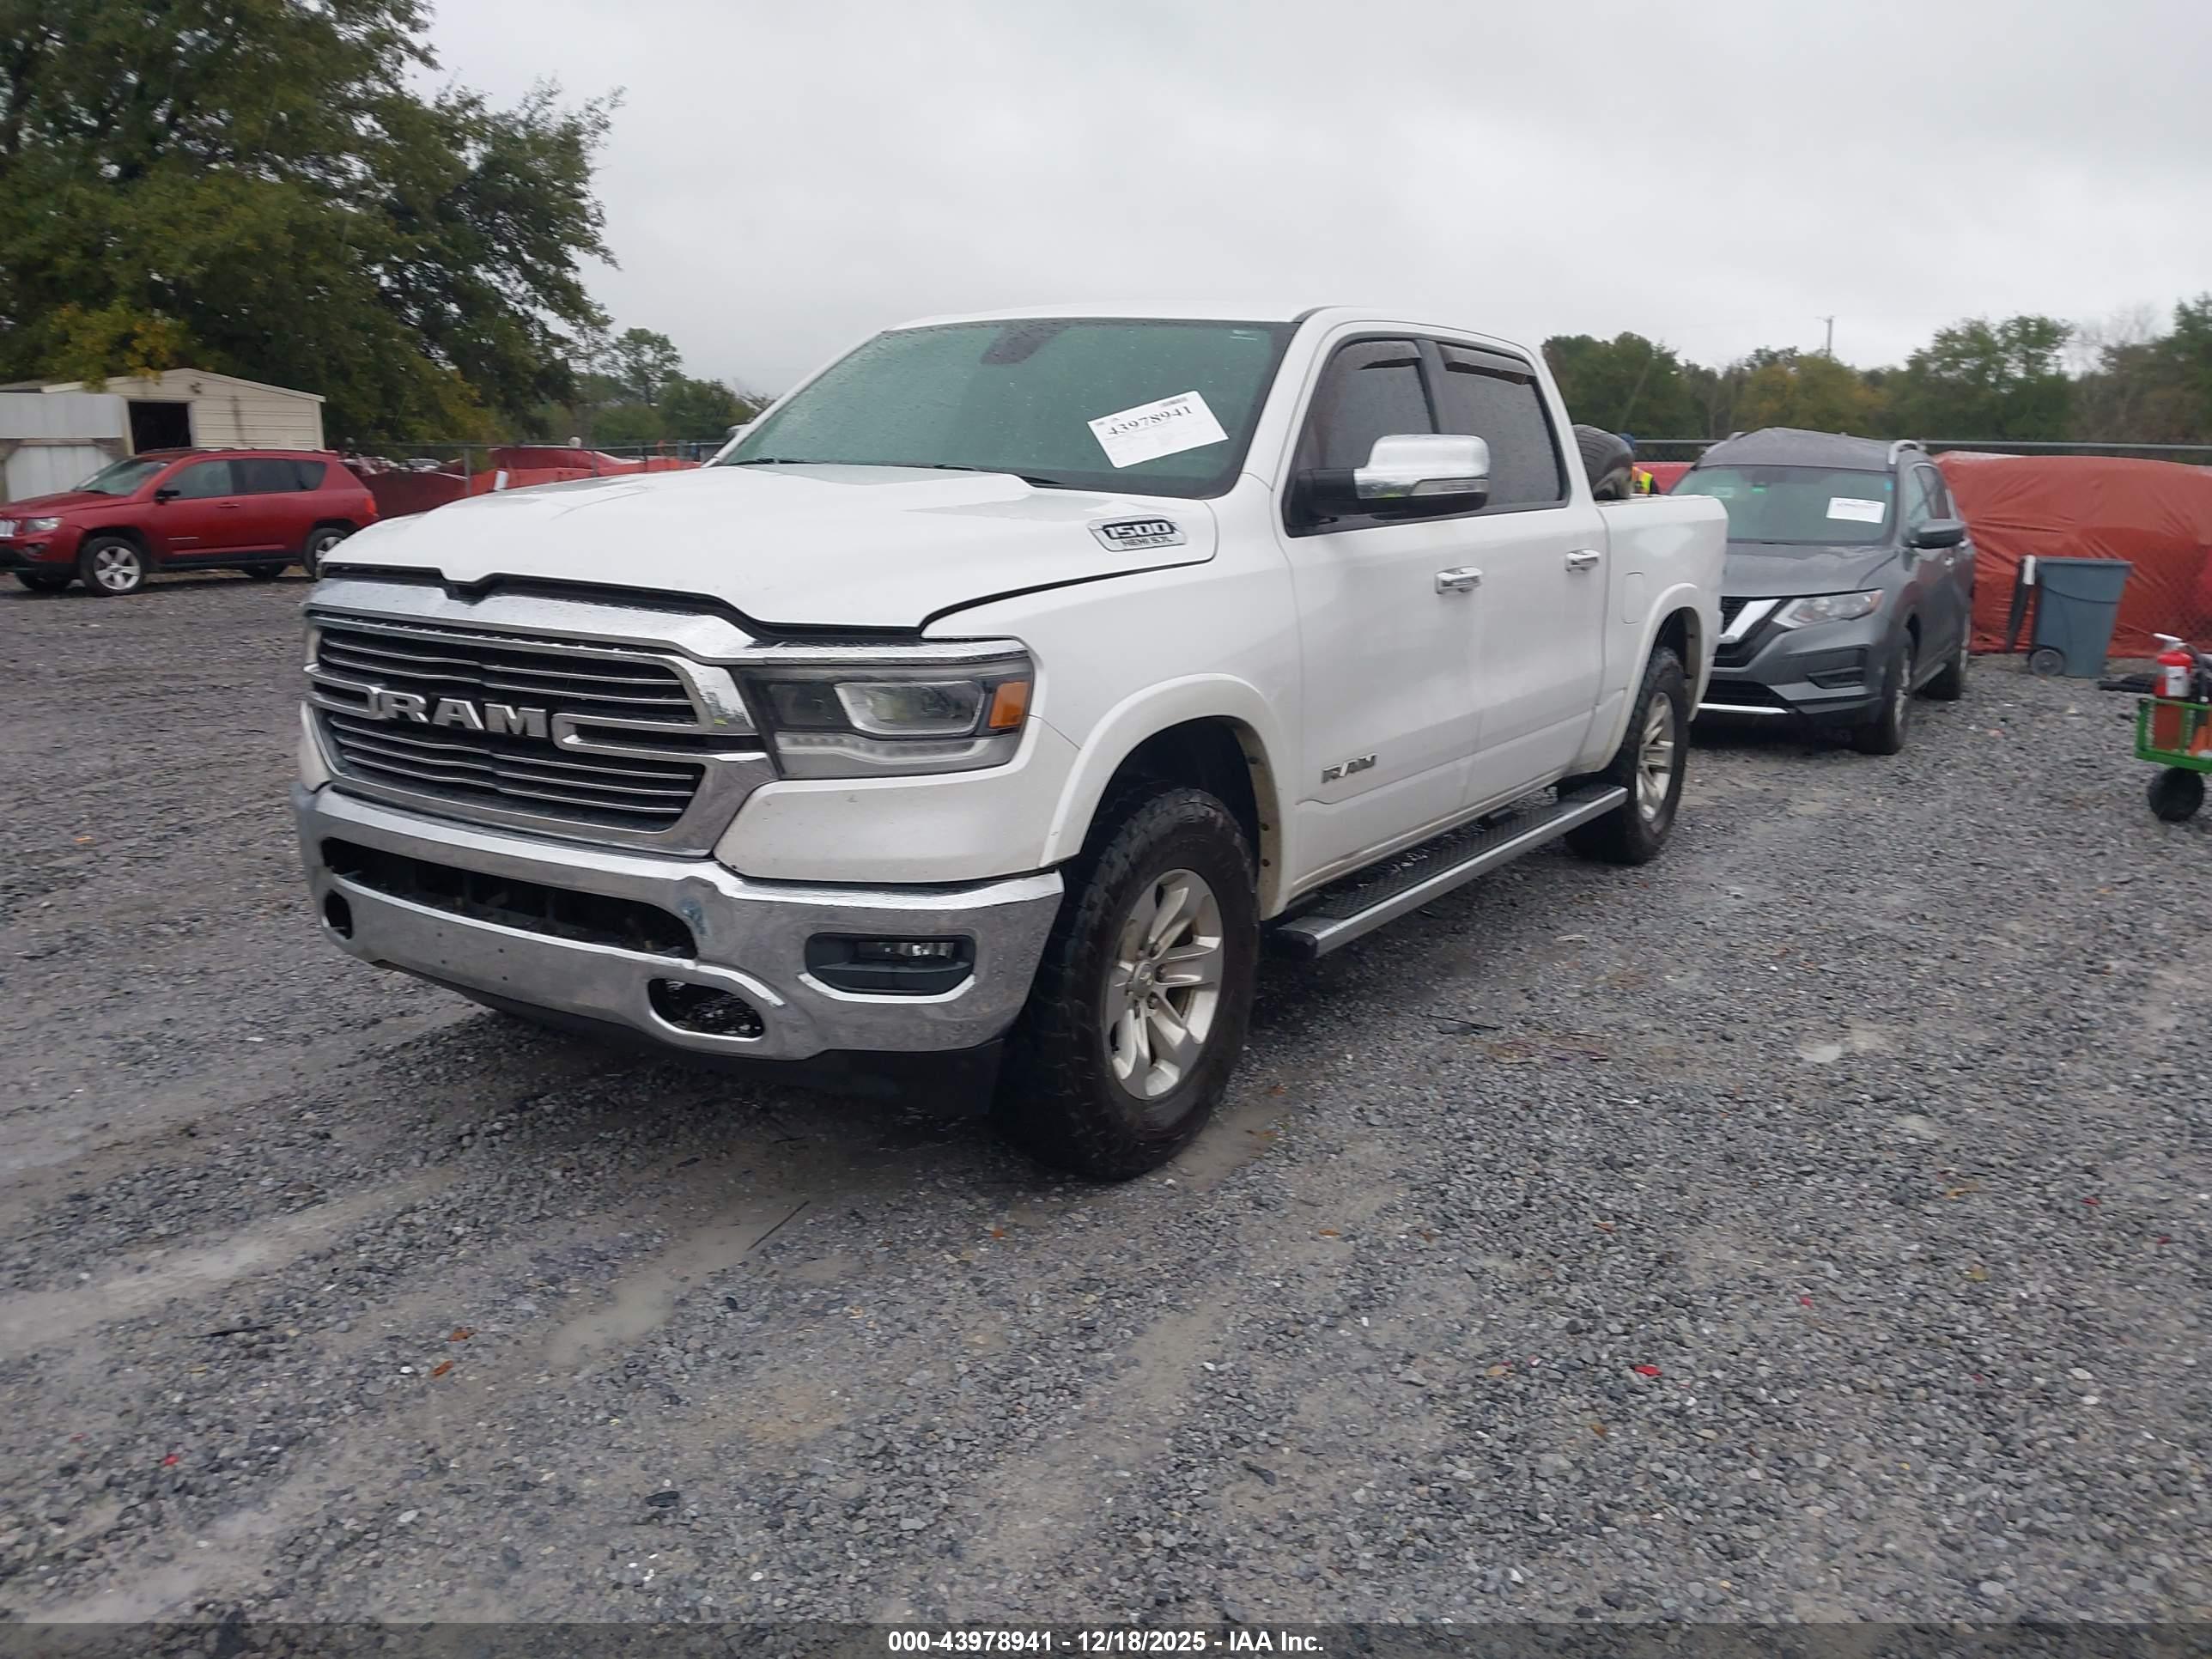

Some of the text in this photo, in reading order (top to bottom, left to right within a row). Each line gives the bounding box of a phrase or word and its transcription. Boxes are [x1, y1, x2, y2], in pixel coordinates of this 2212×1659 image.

[1108, 404, 1194, 436] 43978941
[1103, 522, 1172, 538] 1500
[376, 687, 548, 738] RAM
[1321, 752, 1378, 784] RAM
